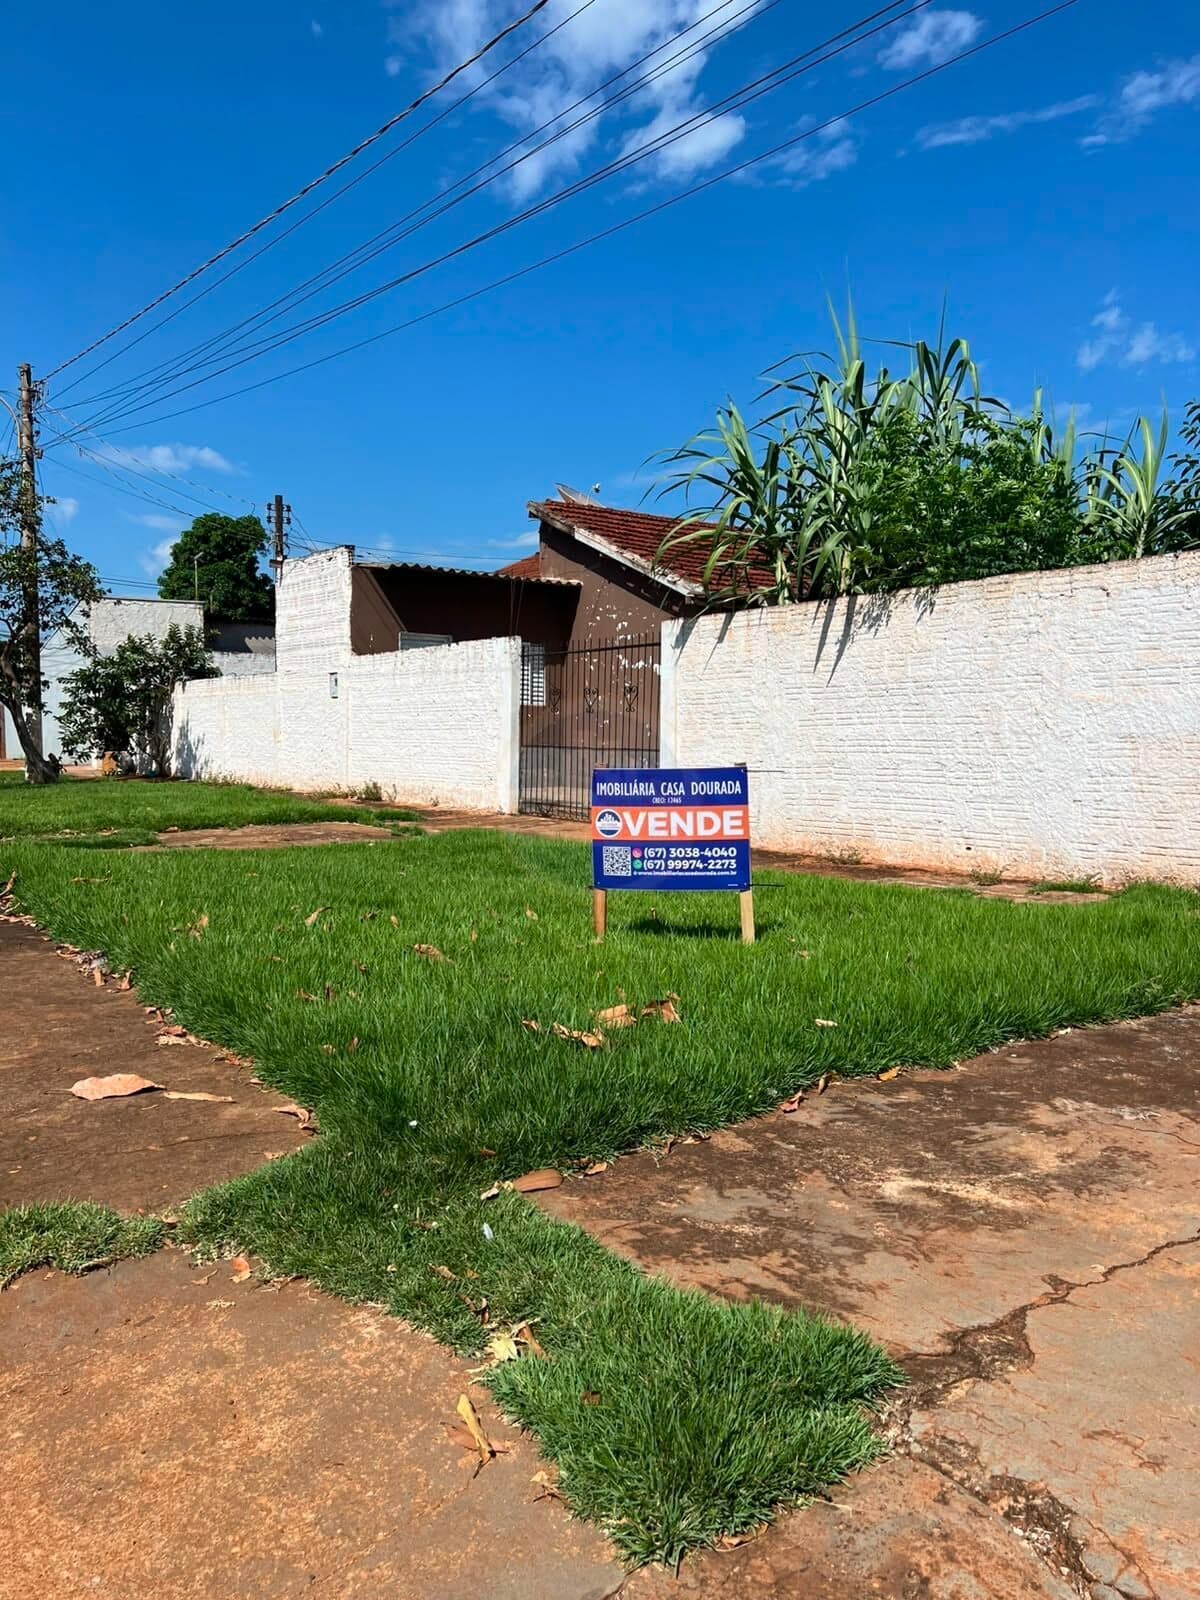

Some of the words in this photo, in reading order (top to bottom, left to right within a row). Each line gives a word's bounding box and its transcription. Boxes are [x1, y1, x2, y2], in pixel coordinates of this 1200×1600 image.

[596, 779, 656, 796] IMOBILIÁRIA
[660, 782, 685, 796] CASA
[691, 780, 742, 795] DOURADA
[622, 810, 745, 837] VENDE
[644, 847, 666, 859] (67)
[668, 847, 737, 858] 3038-4040
[643, 859, 665, 871] (67)
[667, 859, 737, 870] 99974-2273
